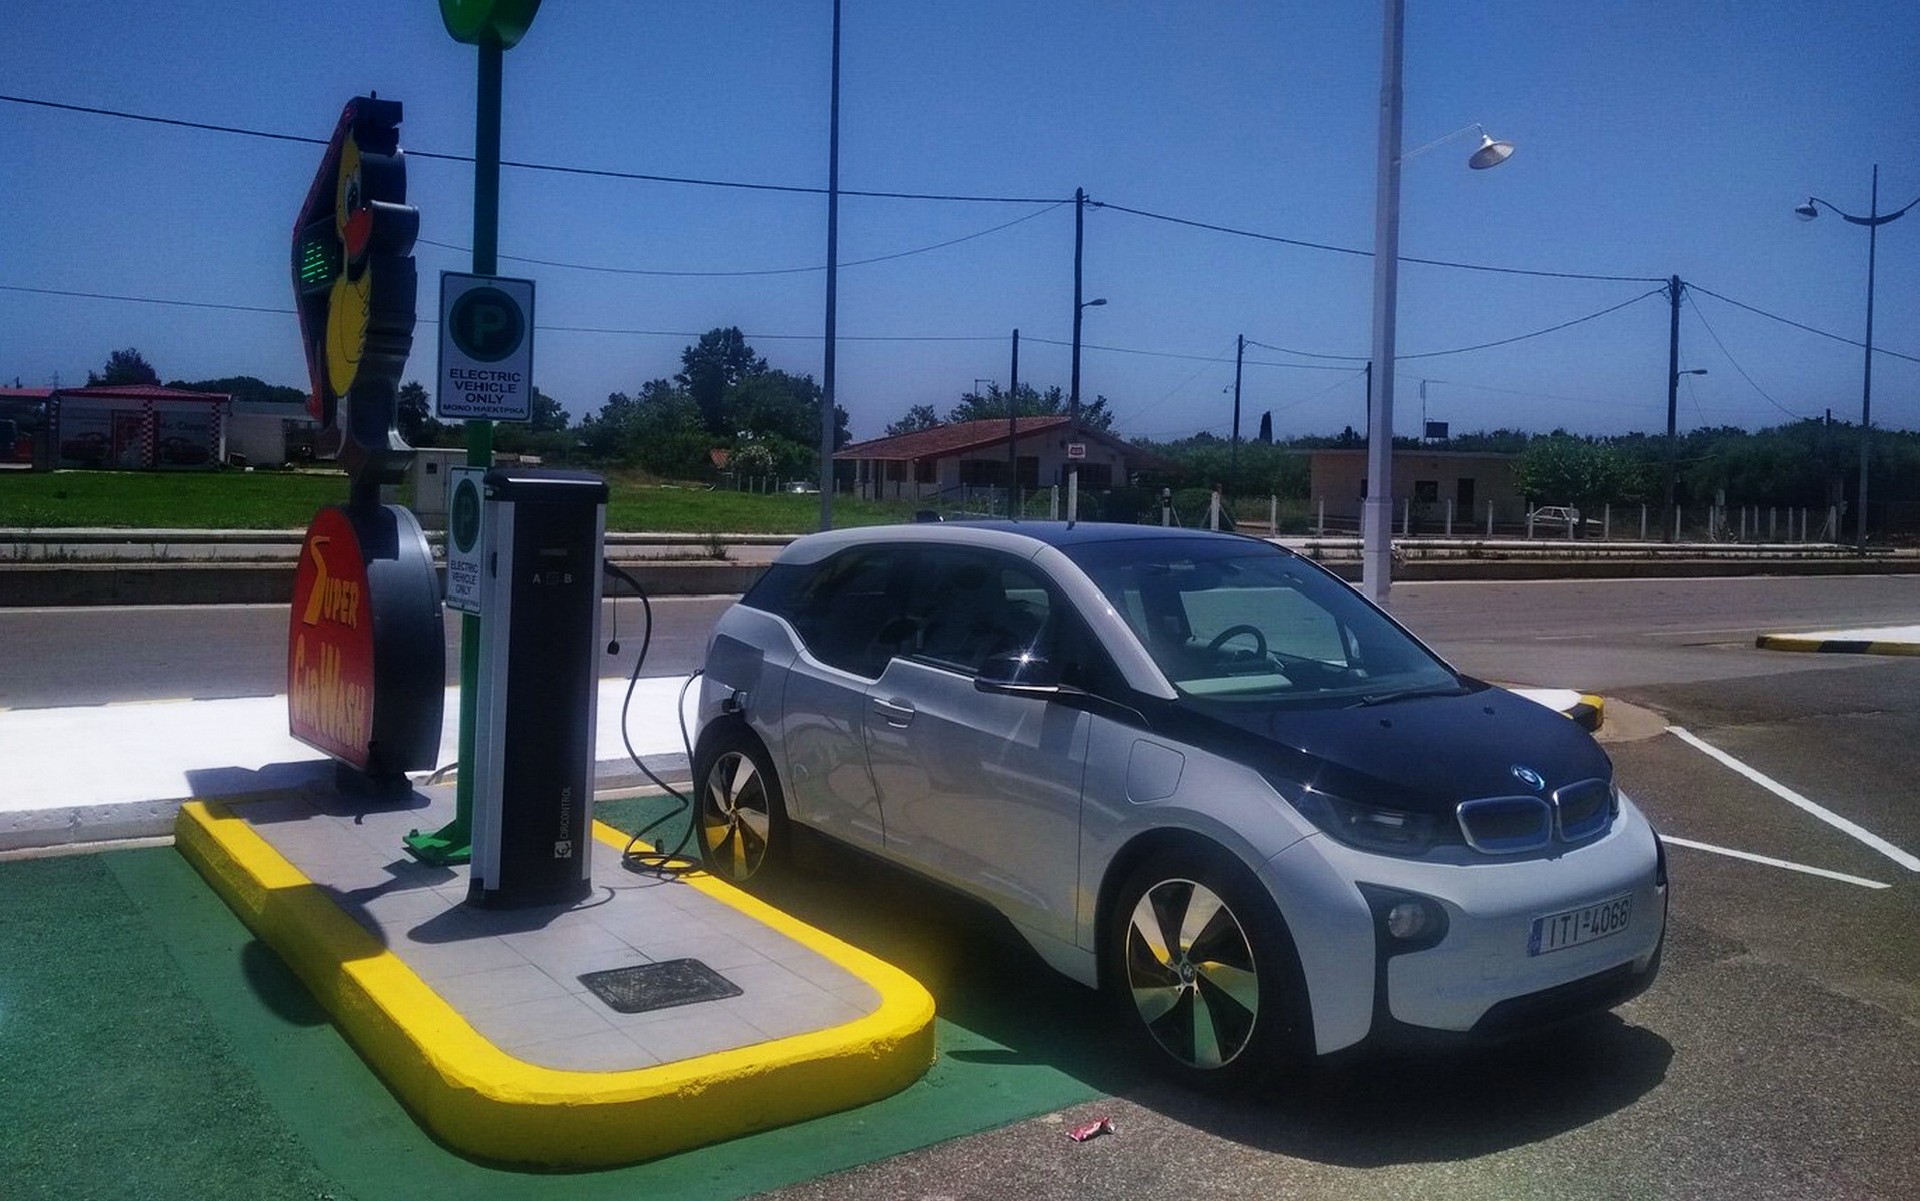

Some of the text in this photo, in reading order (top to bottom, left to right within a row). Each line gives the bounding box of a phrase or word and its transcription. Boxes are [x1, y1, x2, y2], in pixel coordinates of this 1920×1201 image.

[473, 304, 507, 347] P
[449, 368, 522, 383] ELECTRIC
[454, 381, 517, 394] VEHICLE
[465, 392, 505, 404] ONLY
[450, 560, 479, 574] ELECTRIC
[303, 535, 359, 630] SUPER
[452, 571, 477, 585] VEHICLE
[532, 573, 572, 584] A B
[455, 583, 472, 595] ONLY
